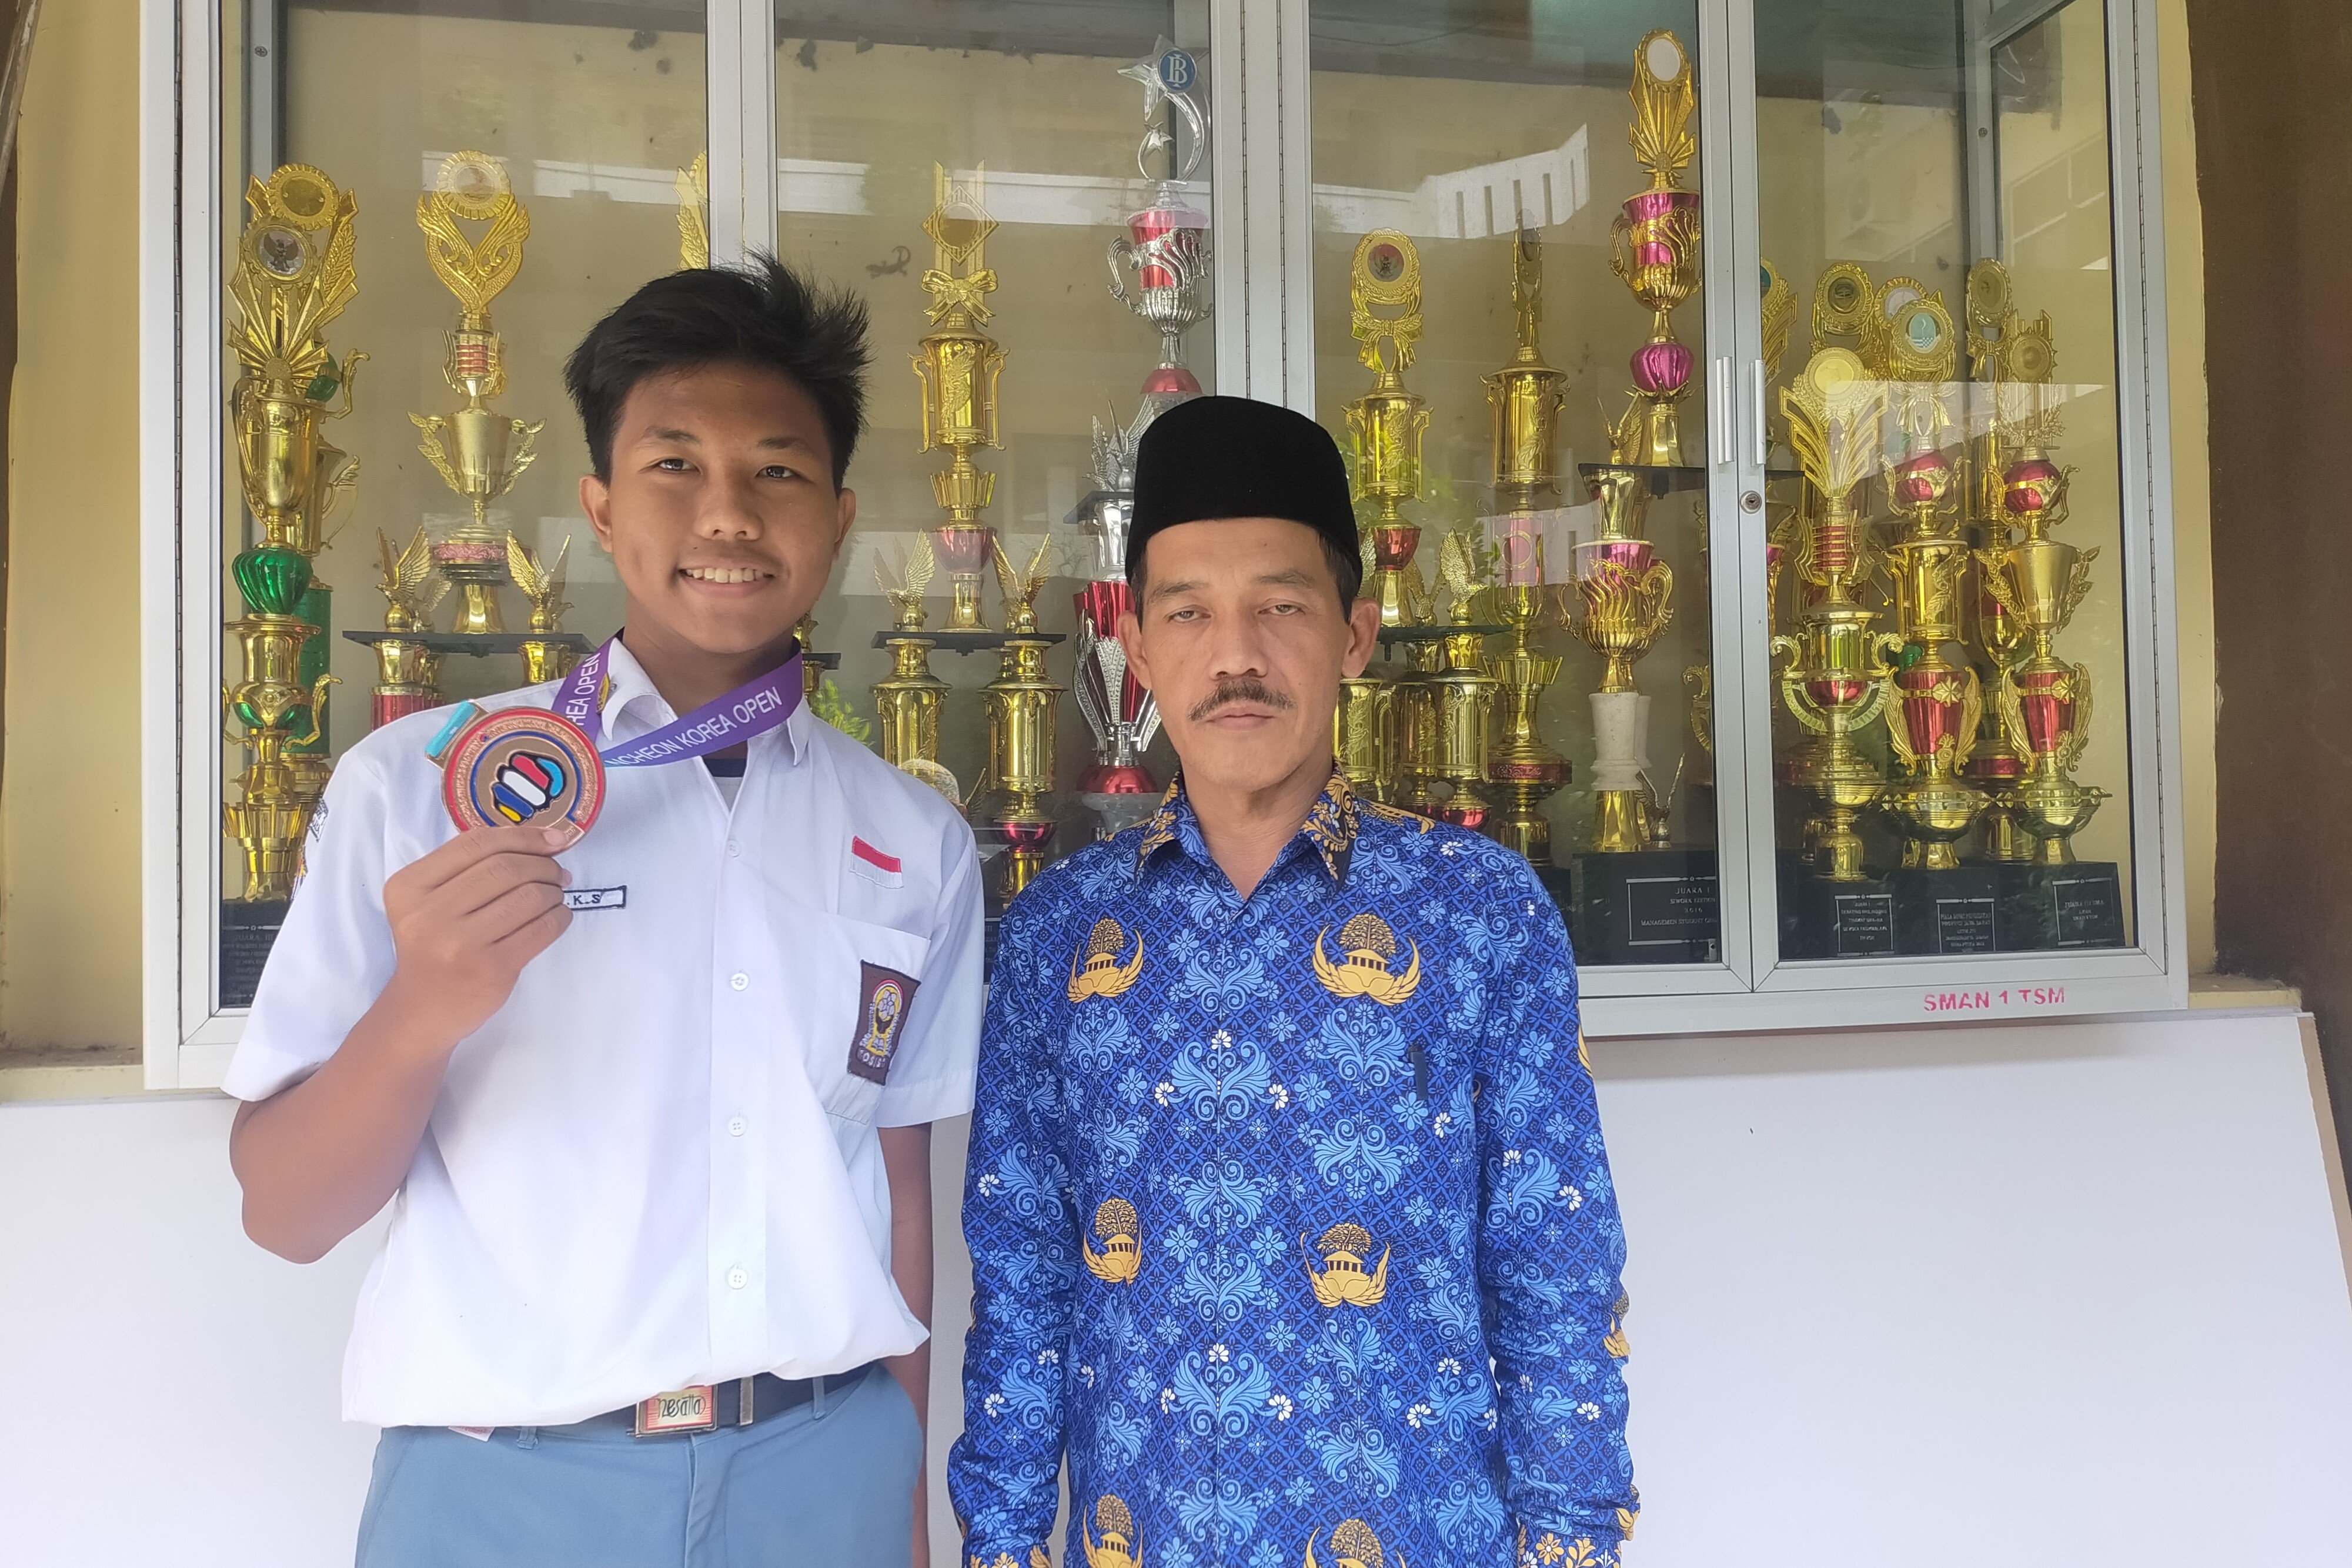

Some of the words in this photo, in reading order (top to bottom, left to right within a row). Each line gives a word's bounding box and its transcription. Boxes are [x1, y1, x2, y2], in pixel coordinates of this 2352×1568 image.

[574, 653, 601, 695] OPEN
[604, 739, 684, 765] NCHEON
[674, 713, 738, 745] KOREA
[733, 686, 783, 723] OPEN
[1923, 991, 1989, 1011] SMAN
[1999, 990, 2008, 1004] 1
[2019, 987, 2065, 1005] TSM
